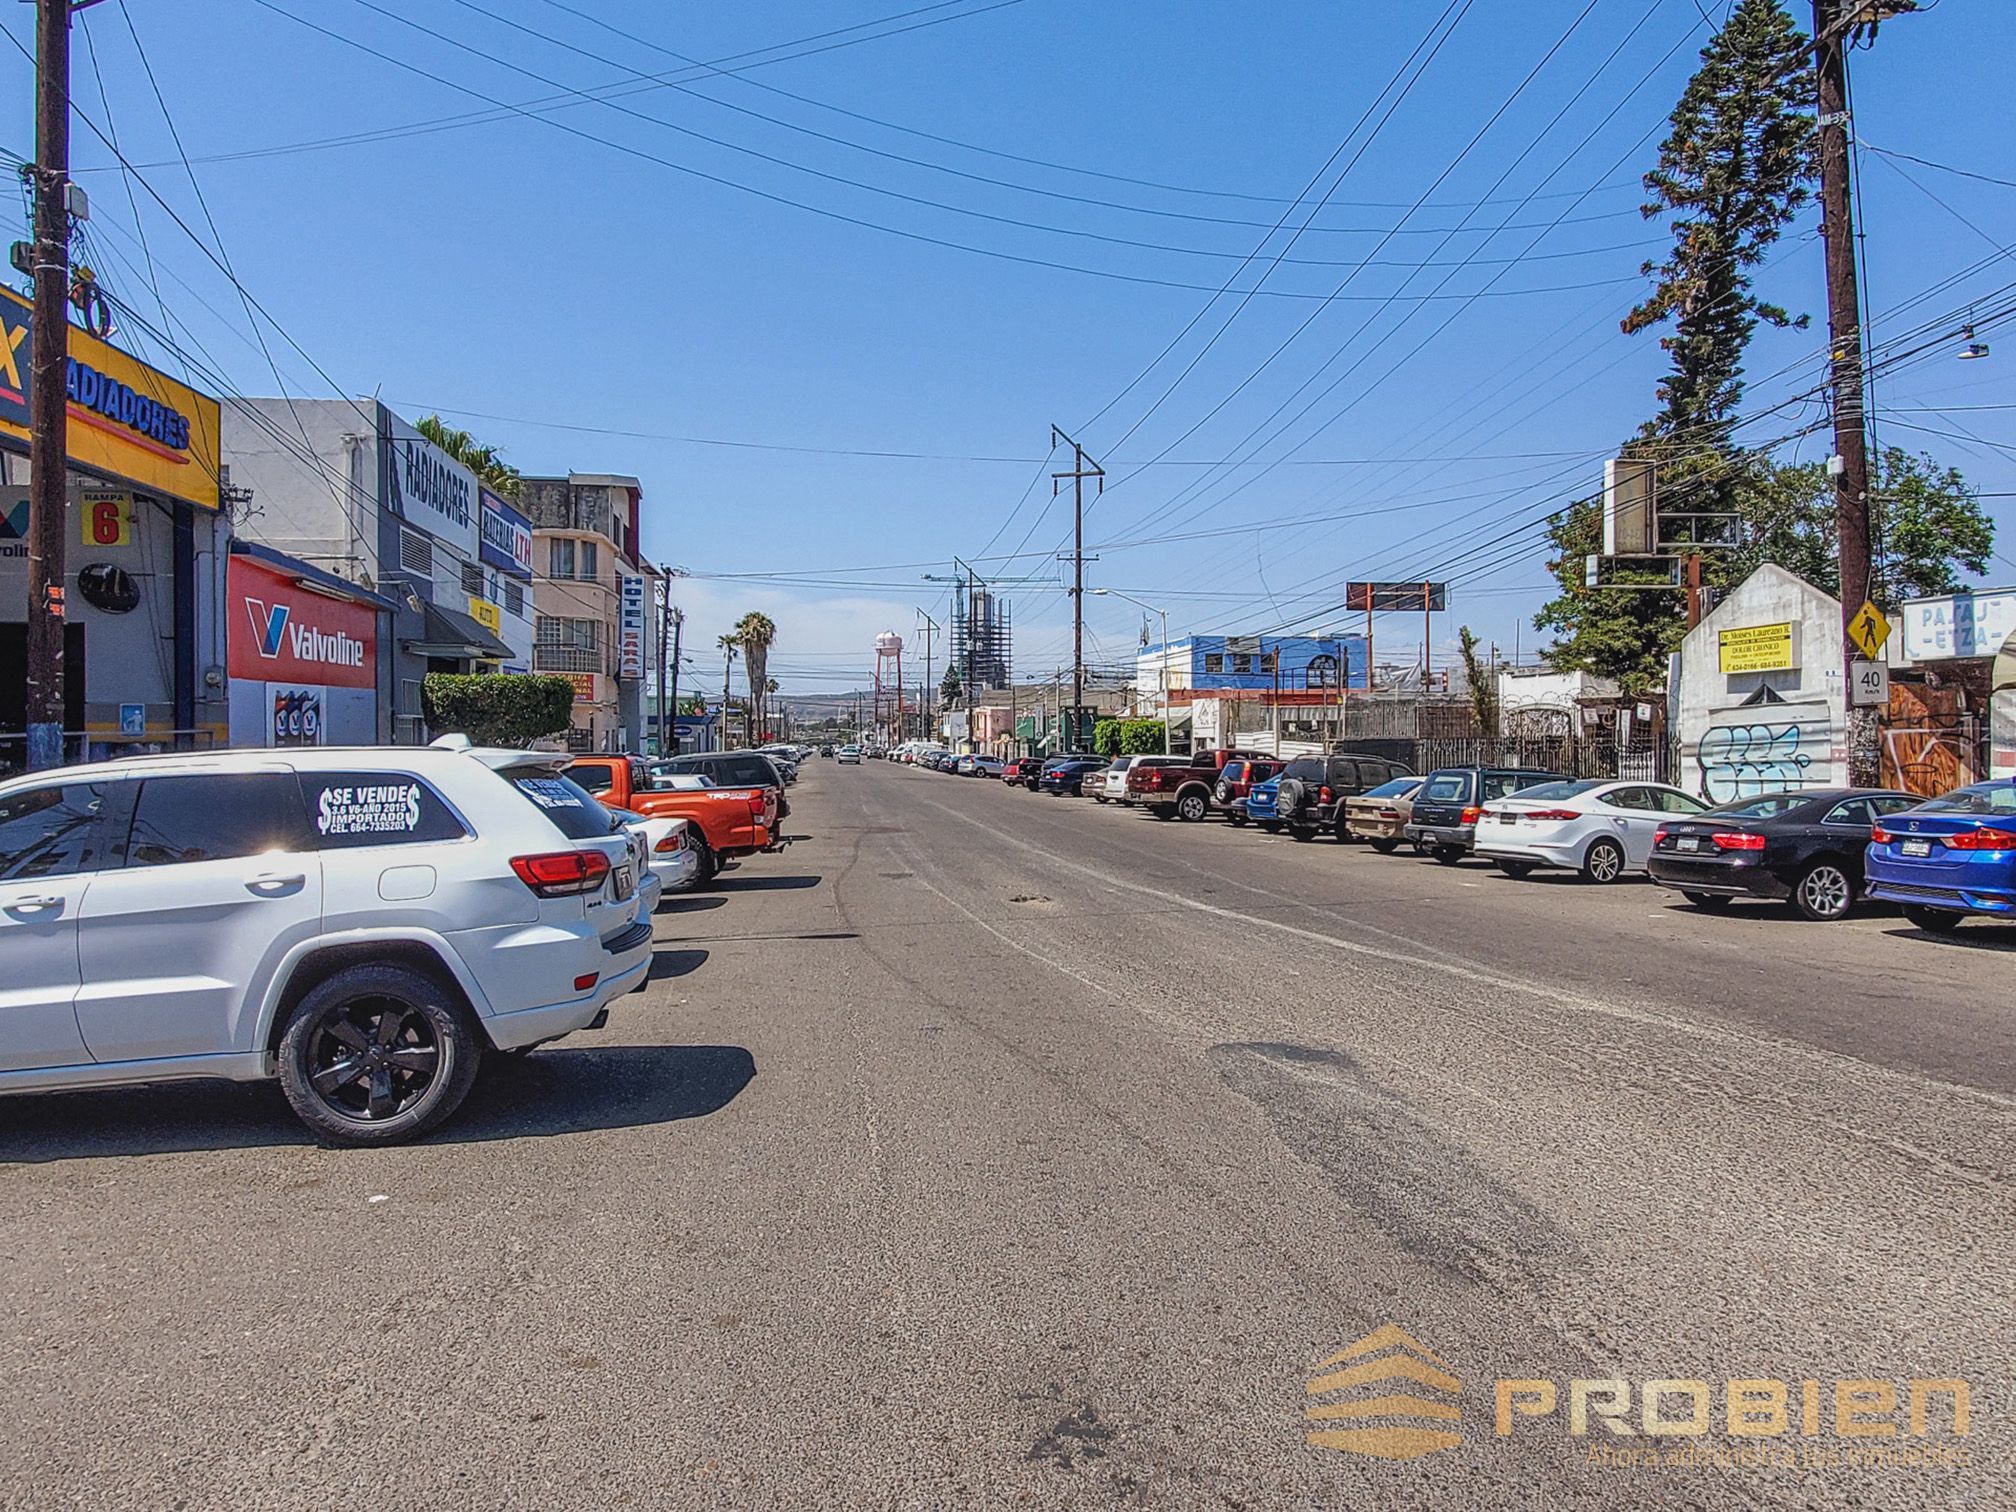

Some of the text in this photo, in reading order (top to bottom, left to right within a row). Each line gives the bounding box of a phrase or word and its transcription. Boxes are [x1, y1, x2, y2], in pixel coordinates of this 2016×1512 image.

[67, 356, 190, 449] ADIADORES
[406, 439, 470, 530] RADIADORES
[92, 502, 119, 544] 6
[515, 531, 531, 565] LTH
[289, 622, 364, 667] Valvoline
[1861, 672, 1880, 687] 40
[333, 787, 352, 805] SE
[357, 786, 408, 803] VENDE
[383, 803, 407, 812] 2015
[332, 812, 405, 824] IMPORTADO
